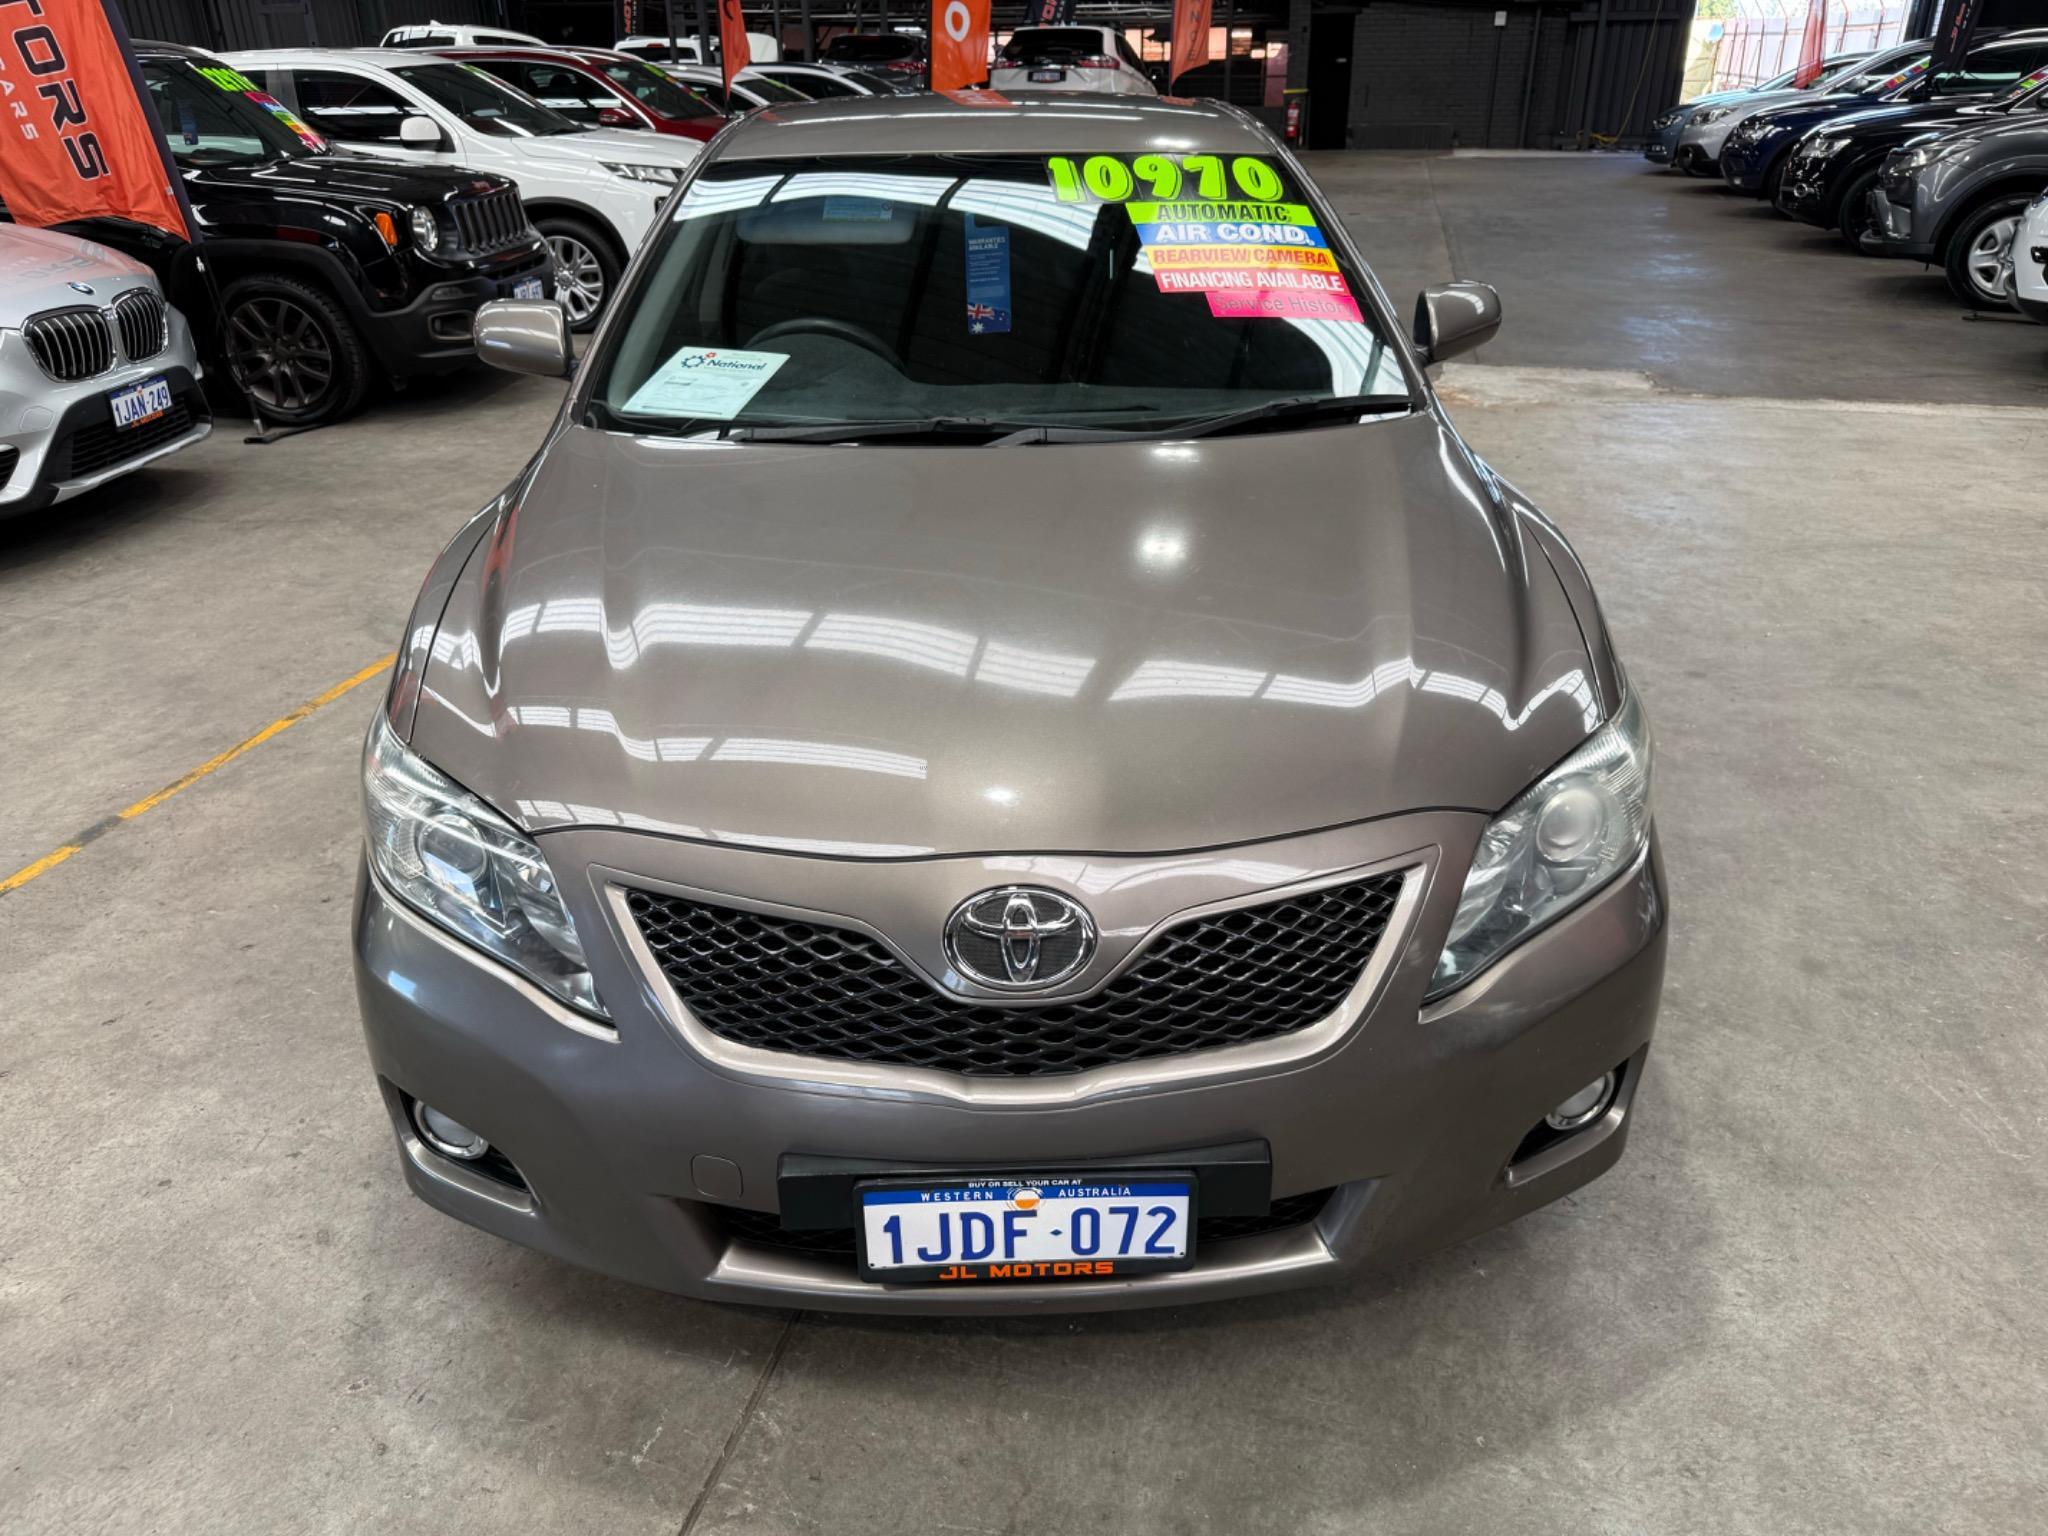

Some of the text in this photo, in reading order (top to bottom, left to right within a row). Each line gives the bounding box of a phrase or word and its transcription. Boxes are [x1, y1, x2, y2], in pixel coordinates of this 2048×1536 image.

[1048, 155, 1284, 201] 10970
[1157, 203, 1292, 223] AUTOMATIC
[1155, 223, 1315, 246] AIR COND.
[1153, 247, 1331, 266] REARVIEW CAMERA
[1160, 271, 1344, 292] FINANCING AVAILABLE
[1214, 295, 1284, 312] Service
[706, 358, 768, 371] National
[1002, 1180, 1024, 1188] SELL
[921, 1187, 1131, 1202] WESTERN AUSTRALIA
[938, 1261, 1113, 1279] JL MOTORS
